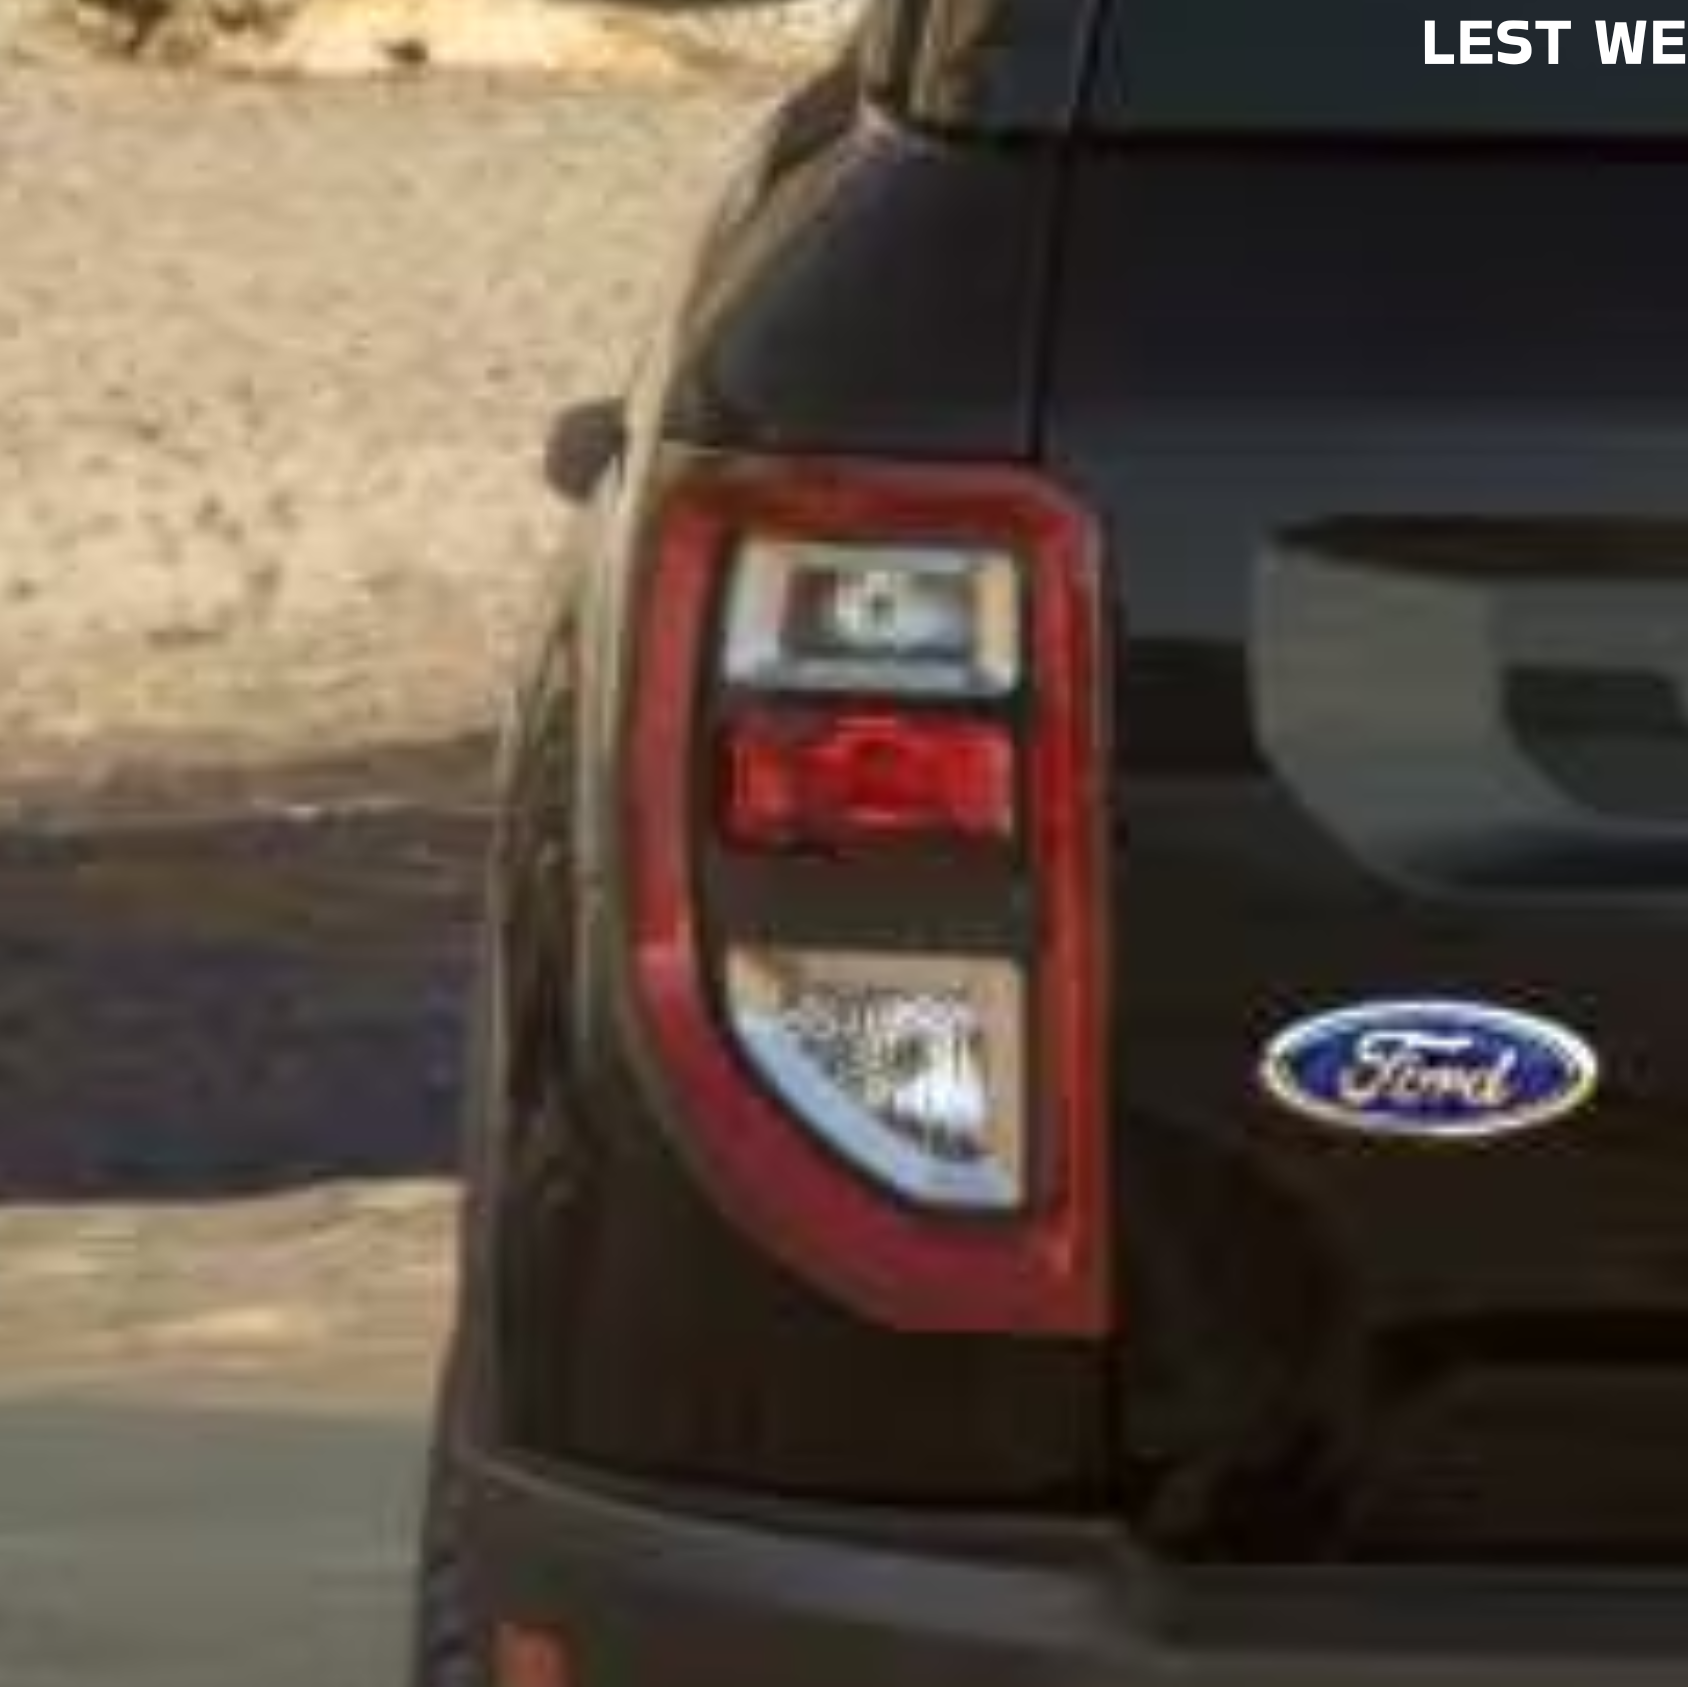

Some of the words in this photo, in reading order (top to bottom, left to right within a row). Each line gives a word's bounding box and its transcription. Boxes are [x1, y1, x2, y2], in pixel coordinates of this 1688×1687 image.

[1424, 19, 1572, 65] LEST
[1594, 19, 1686, 65] WE
[1338, 1029, 1517, 1108] Ford
